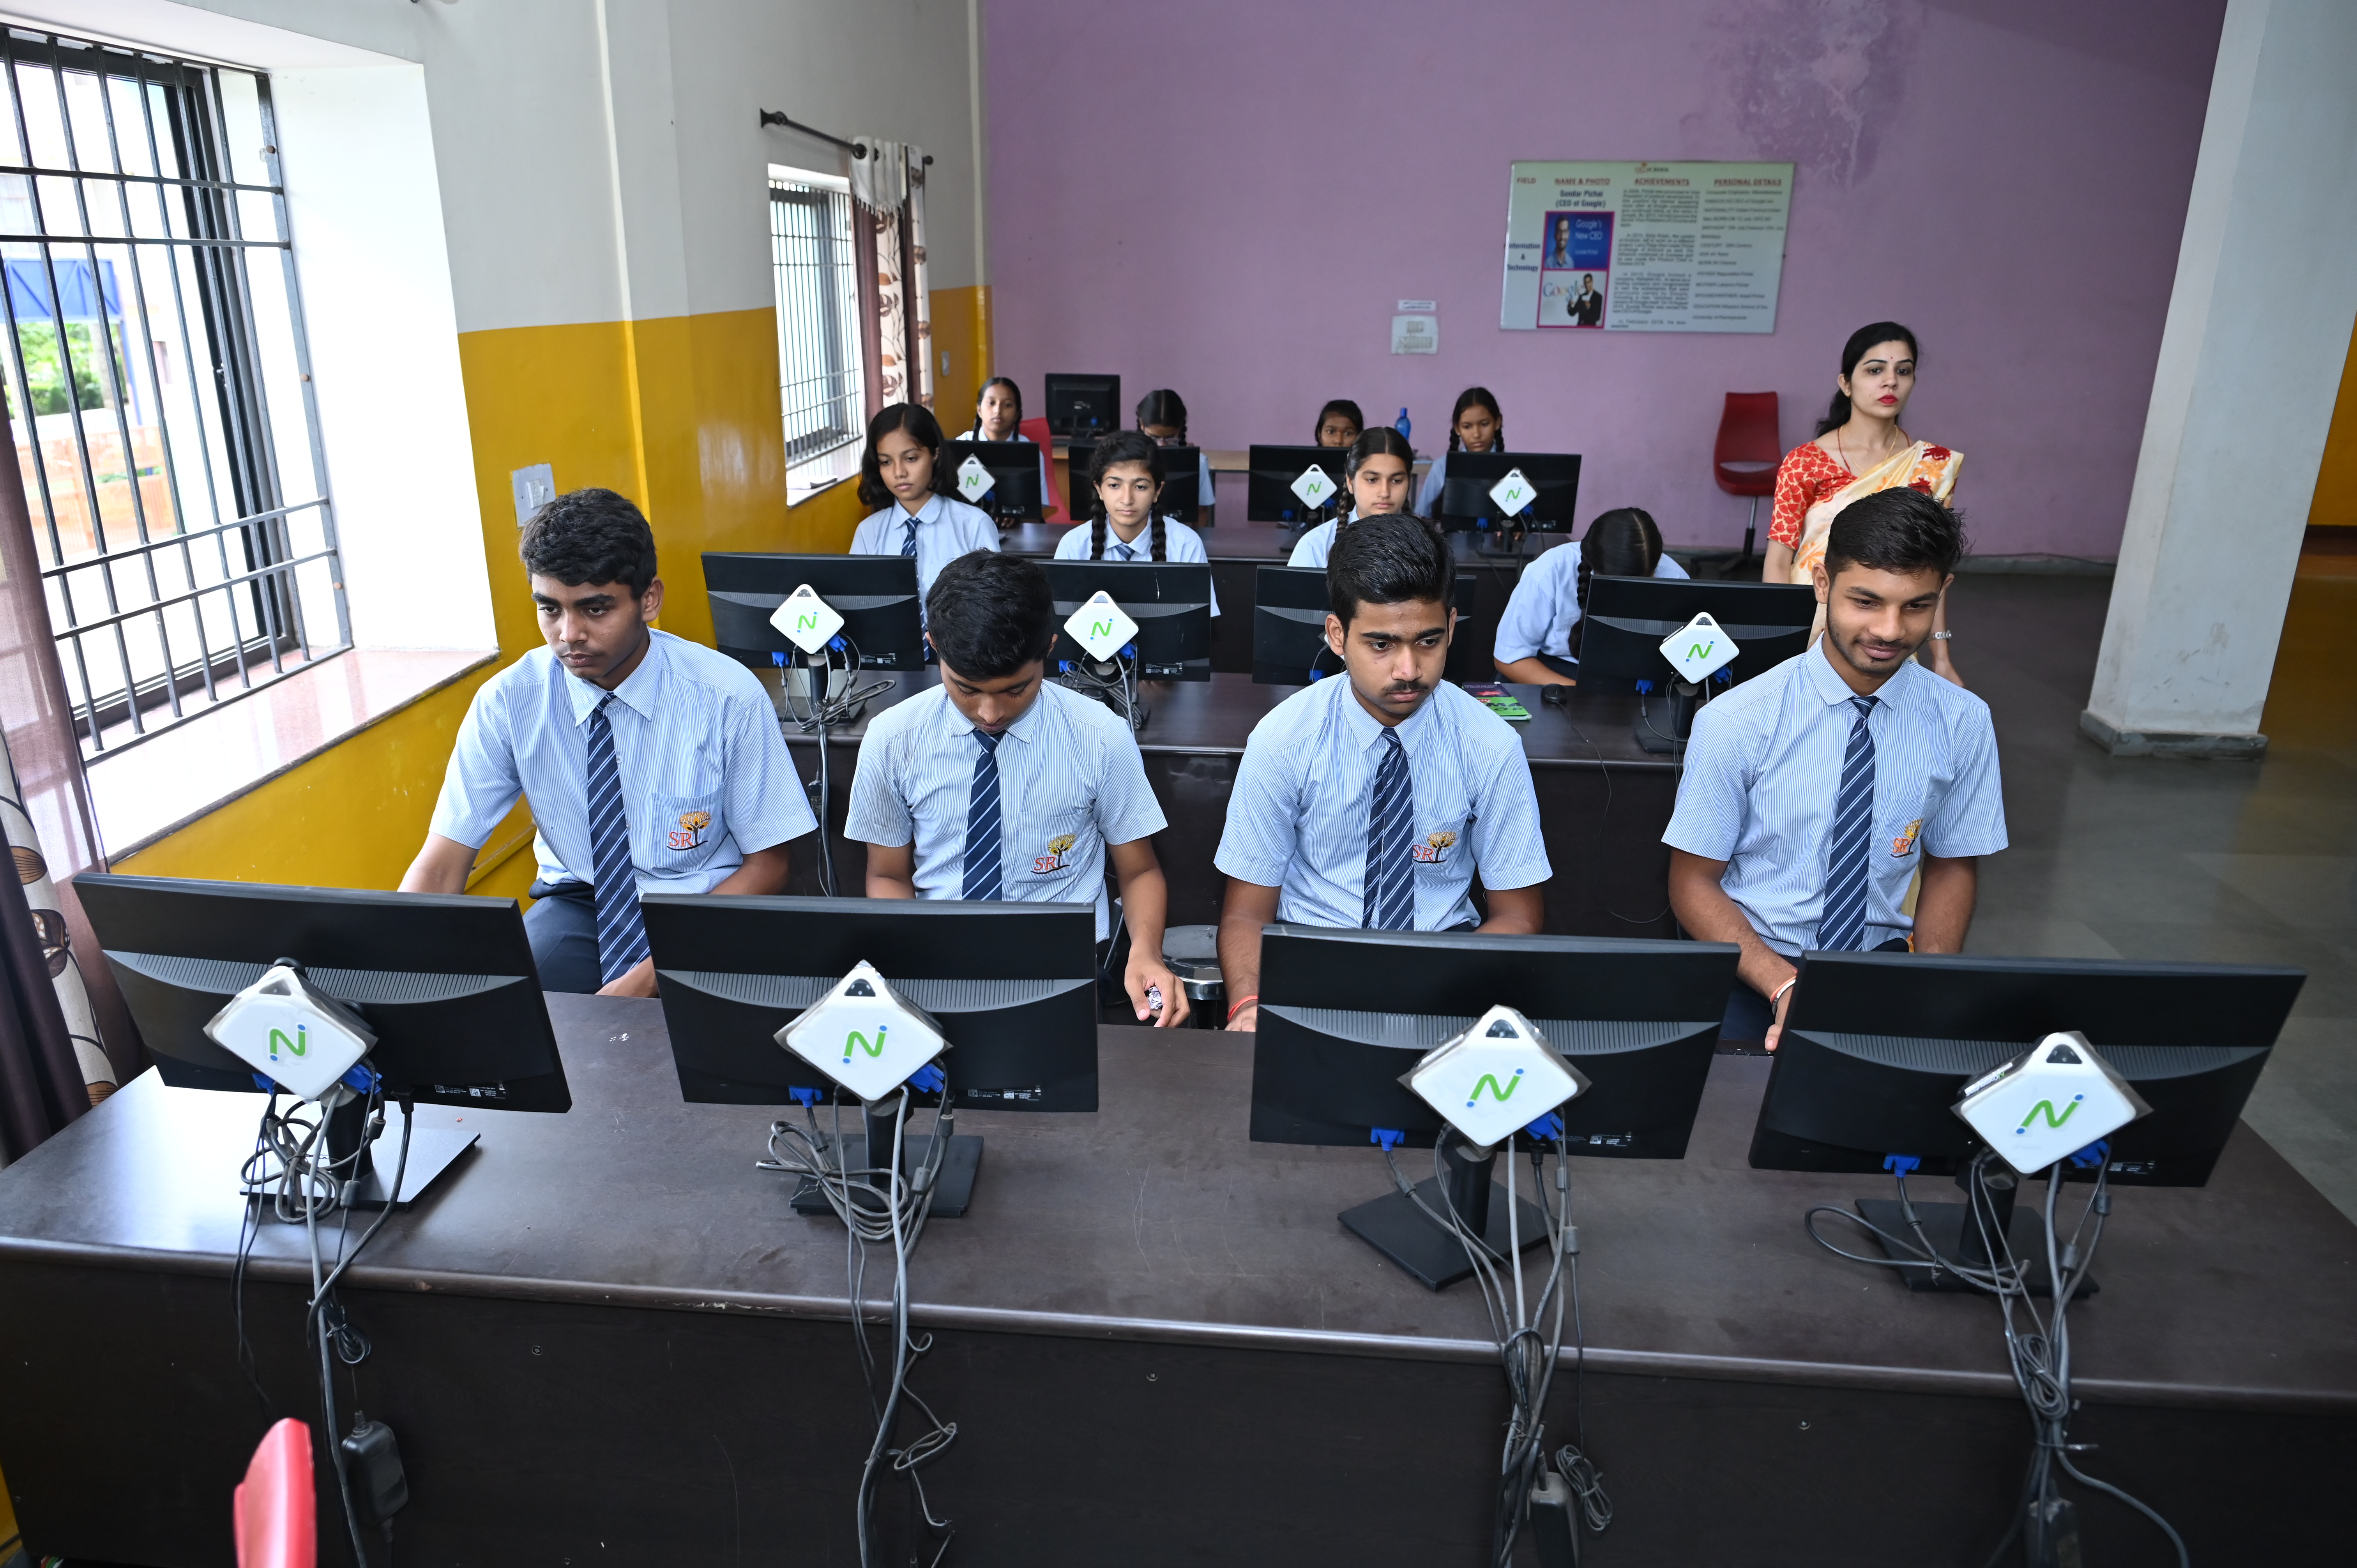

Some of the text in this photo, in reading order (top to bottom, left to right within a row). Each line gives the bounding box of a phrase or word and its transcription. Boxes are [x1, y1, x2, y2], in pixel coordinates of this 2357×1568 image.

[1581, 200, 1606, 208] Google)
[1576, 219, 1602, 229] Google's
[1575, 231, 1603, 240] New CEO
